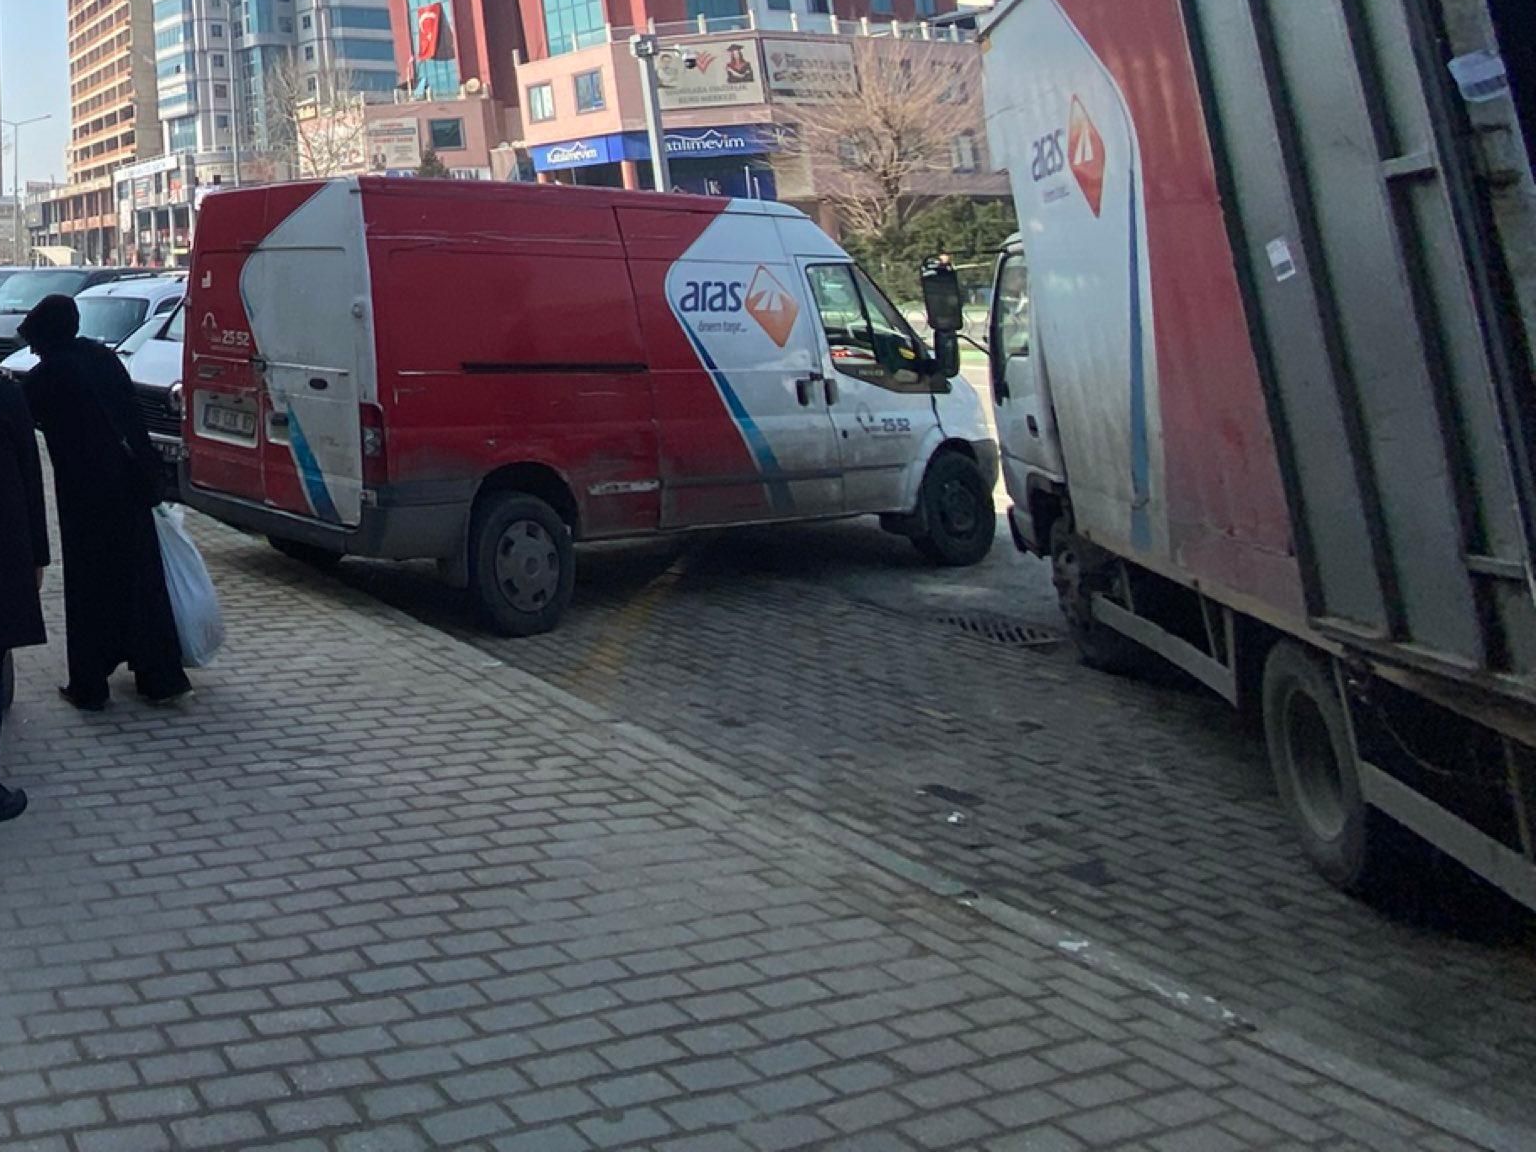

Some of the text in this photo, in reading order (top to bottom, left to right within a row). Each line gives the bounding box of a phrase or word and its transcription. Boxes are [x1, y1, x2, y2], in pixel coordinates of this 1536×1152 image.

[664, 132, 745, 152] atılımevim
[1031, 127, 1065, 182] aras
[680, 280, 742, 313] aras
